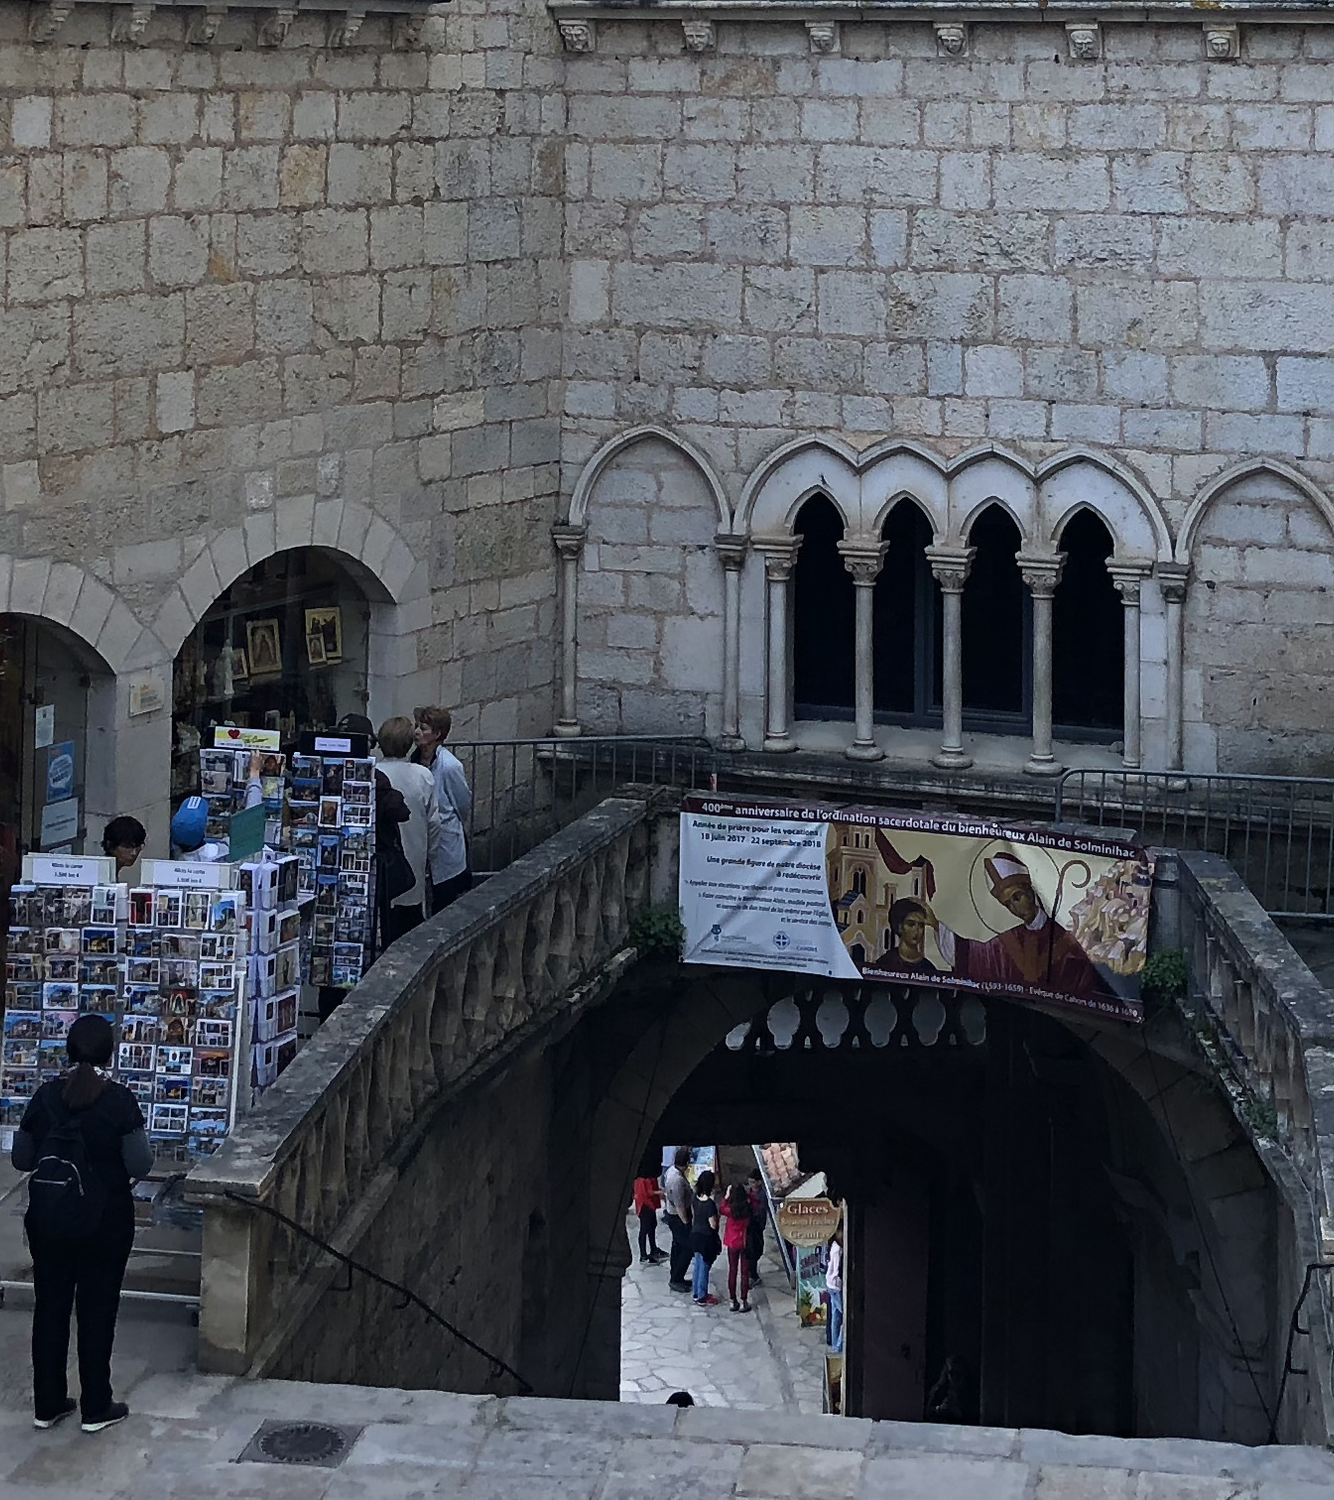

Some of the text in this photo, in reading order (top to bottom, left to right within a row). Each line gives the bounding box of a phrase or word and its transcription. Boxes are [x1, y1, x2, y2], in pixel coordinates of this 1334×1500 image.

[693, 820, 716, 830] Année
[717, 822, 727, 830] de
[728, 823, 750, 833] prière
[751, 826, 769, 834] pour
[771, 826, 781, 834] les
[783, 827, 818, 836] vocations
[735, 806, 799, 818] anniversaire
[801, 810, 815, 820] de
[817, 810, 876, 824] l'ordination
[879, 816, 939, 830] sacerdotale
[941, 821, 955, 832] du
[958, 822, 1025, 841] bienheureux
[1027, 832, 1055, 846] Alain
[1057, 838, 1072, 848] de
[1074, 840, 1135, 858] Solminihac
[711, 834, 726, 842] juin
[727, 835, 745, 843] 2017
[761, 838, 801, 847] septembre
[802, 840, 821, 848] 2018
[707, 856, 720, 864] Une
[862, 967, 909, 979] Bienheureux
[911, 972, 929, 982] Alain
[931, 975, 940, 983] de
[787, 1203, 829, 1214] Glaces
